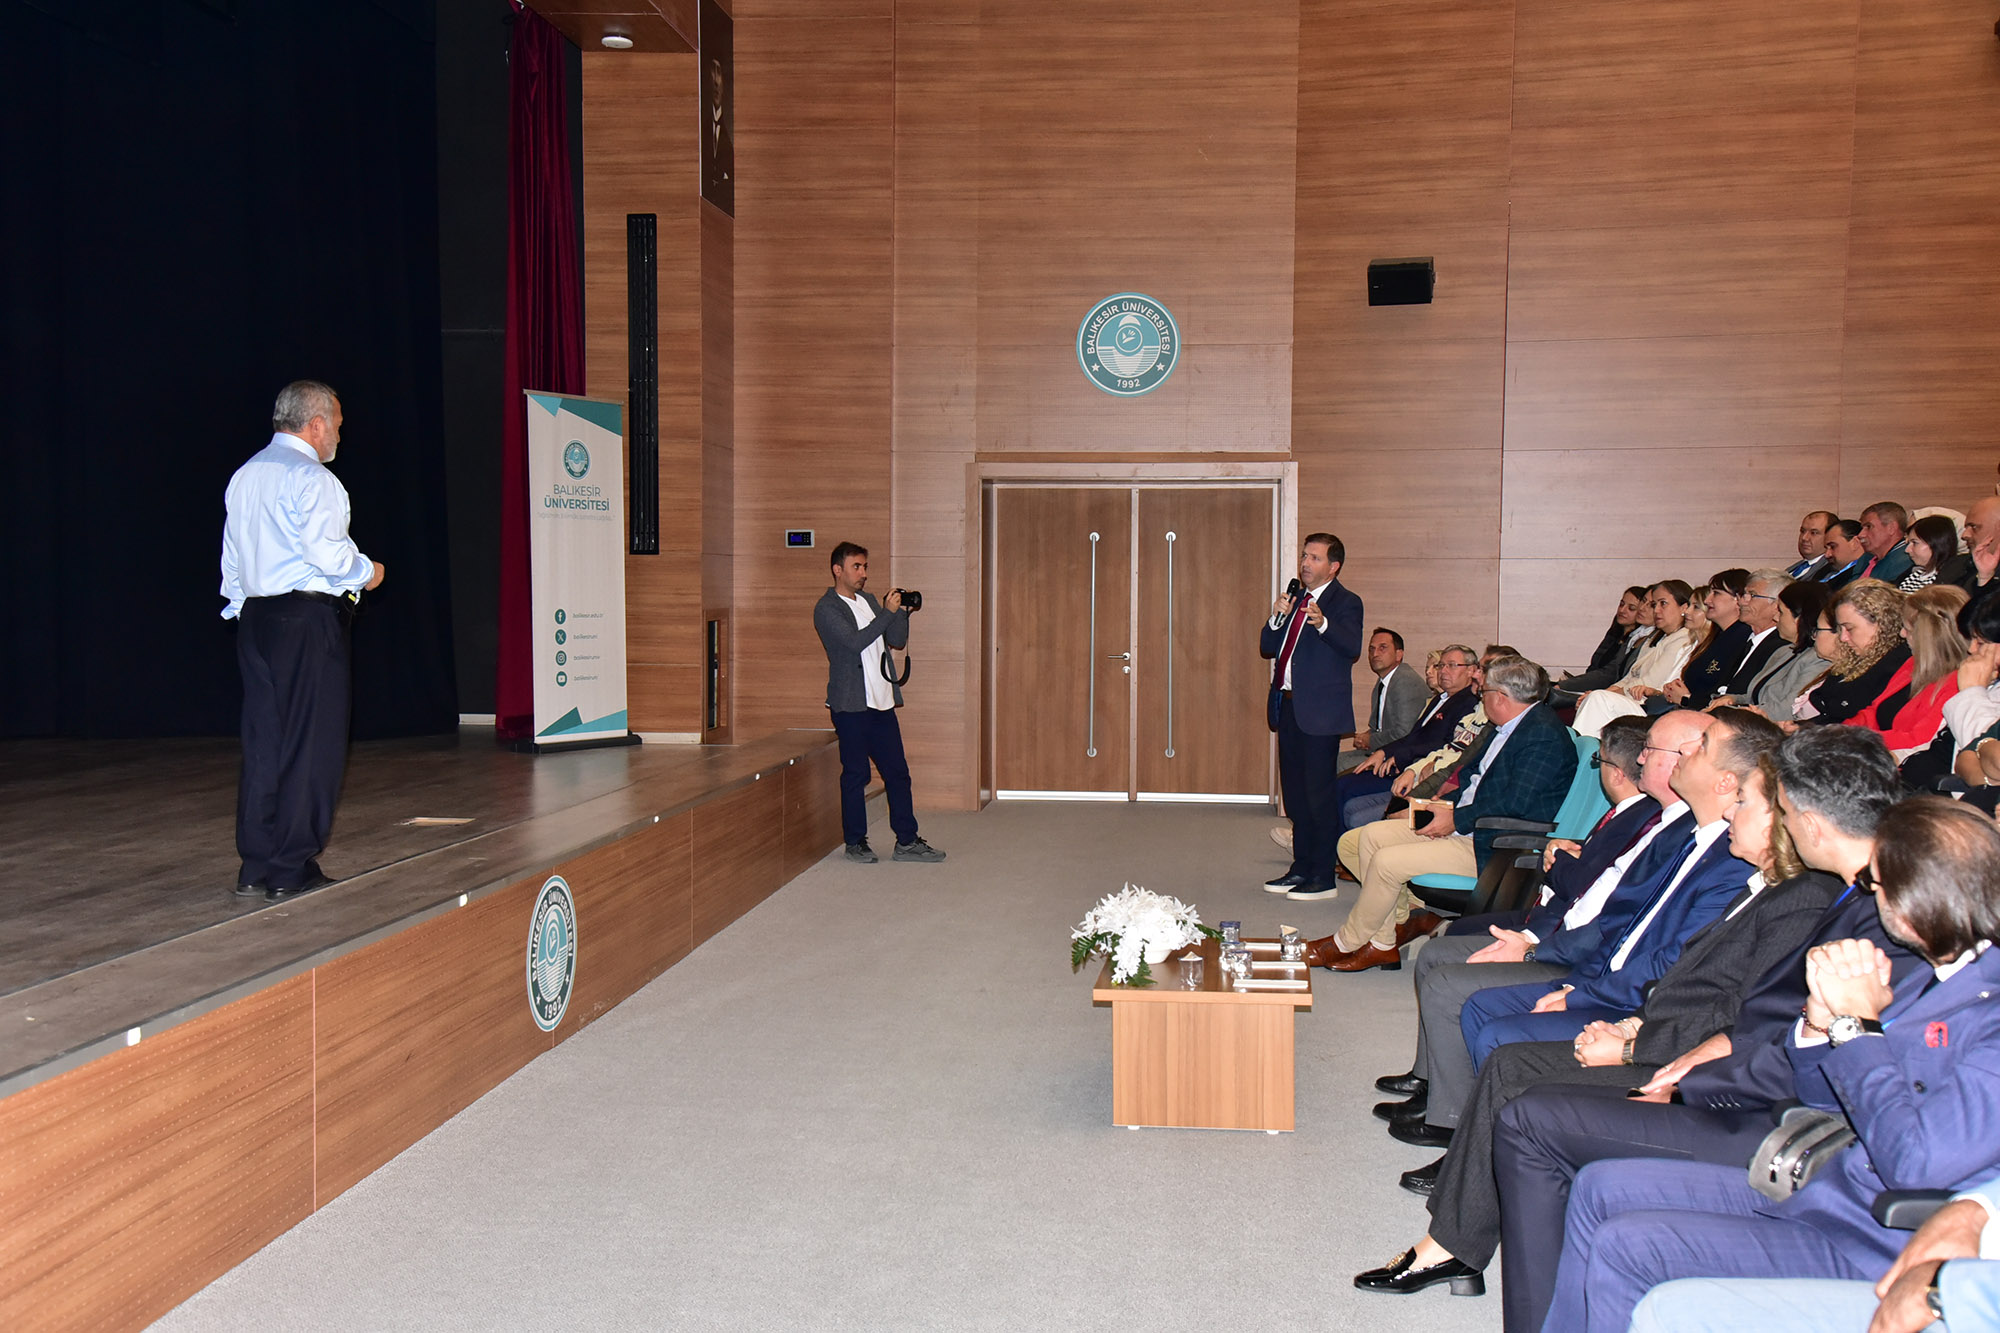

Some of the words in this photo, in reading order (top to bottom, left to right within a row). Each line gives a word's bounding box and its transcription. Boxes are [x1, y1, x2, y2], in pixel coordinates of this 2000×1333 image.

[1087, 304, 1120, 355] BALIKESİR
[1117, 378, 1141, 389] 1992
[553, 484, 601, 497] BALIKESİR
[544, 494, 610, 511] ÜNİVERSİTESİ
[531, 899, 548, 982] BALIKESİR
[544, 995, 562, 1019] 1992
